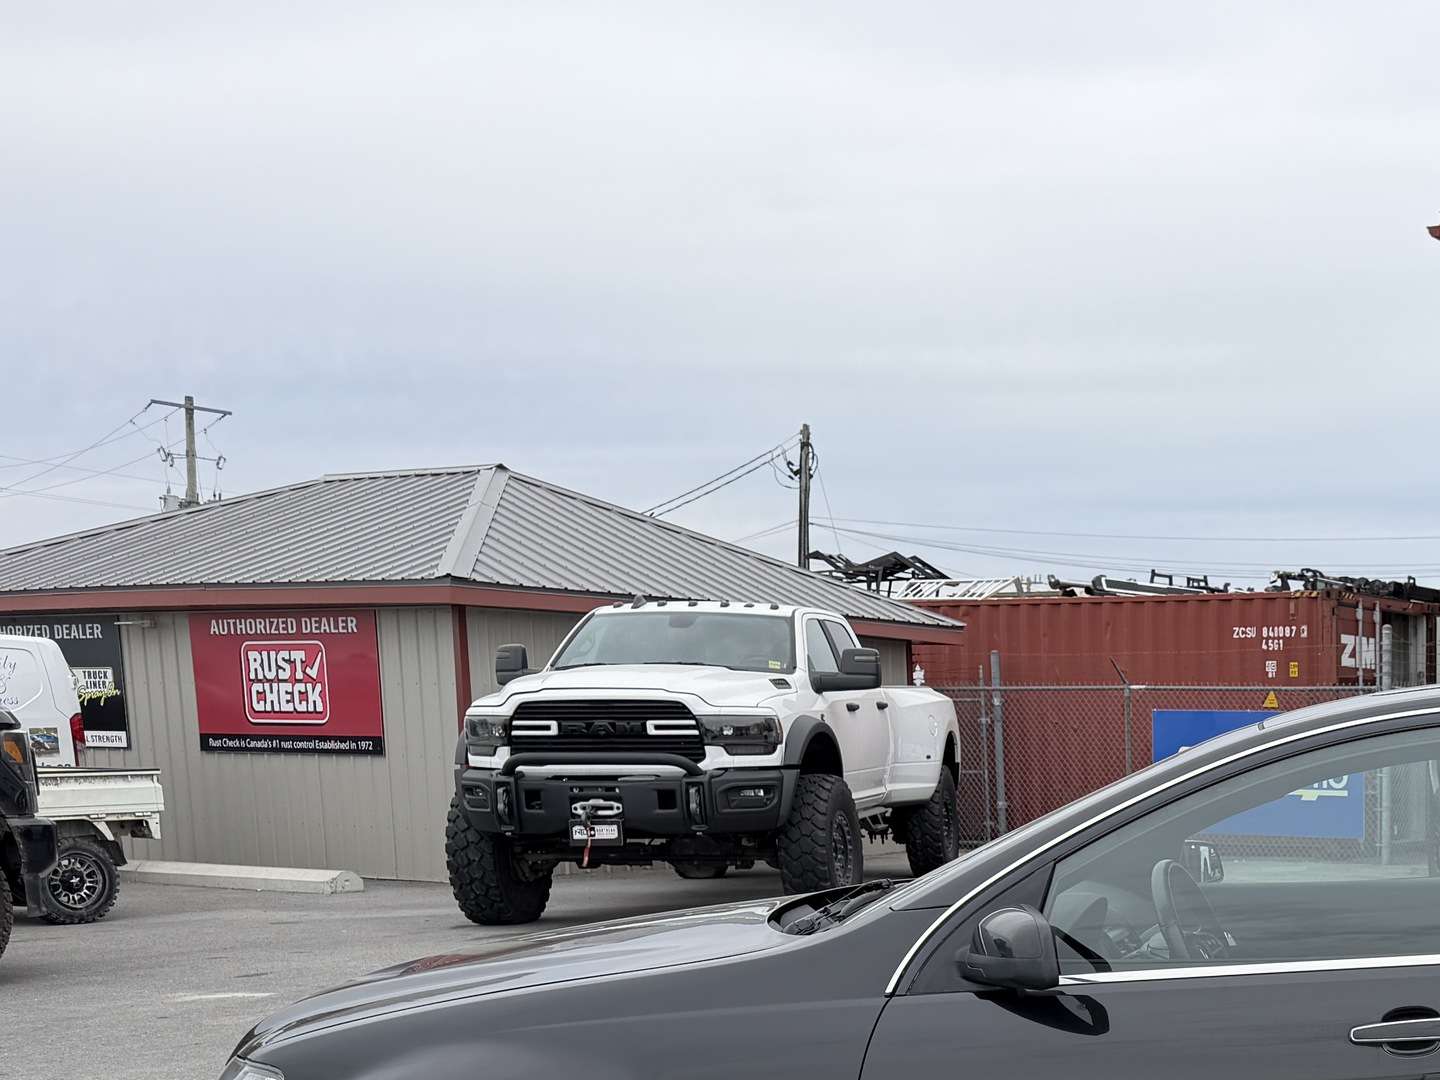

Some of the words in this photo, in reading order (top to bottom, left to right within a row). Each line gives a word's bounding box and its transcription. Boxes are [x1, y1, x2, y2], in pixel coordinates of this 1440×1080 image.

[54, 623, 103, 639] DEALER
[210, 617, 297, 635] AUTHORIZED
[301, 616, 358, 634] DEALER
[1232, 626, 1257, 639] ZCSU
[247, 650, 306, 680] RUST
[82, 670, 109, 680] TRUCK
[86, 680, 107, 690] LINER
[251, 682, 324, 712] CHECK
[208, 738, 222, 747] Rust
[222, 738, 240, 747] Check
[246, 738, 272, 748] Canada's
[281, 741, 293, 749] rust
[293, 740, 315, 749] control
[315, 740, 350, 750] Established
[350, 741, 357, 750] in
[357, 741, 373, 750] 1972
